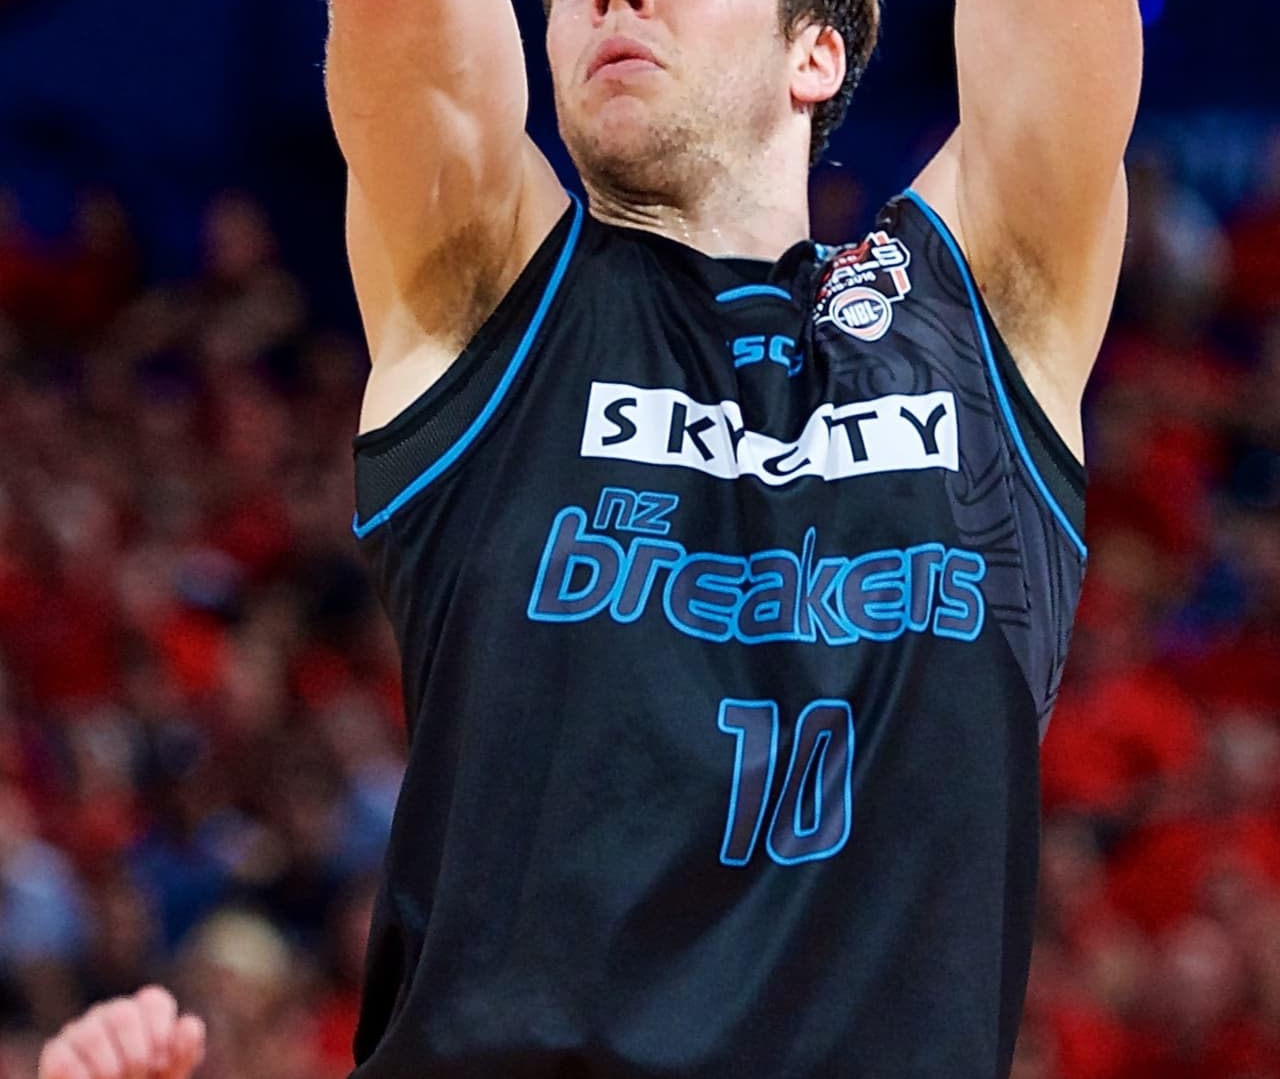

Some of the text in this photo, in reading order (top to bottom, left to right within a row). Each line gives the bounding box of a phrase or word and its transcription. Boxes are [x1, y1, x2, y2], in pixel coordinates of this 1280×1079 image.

[842, 300, 880, 327] NBL
[601, 397, 947, 476] SKCTY
[526, 506, 986, 647] breakers
[718, 698, 855, 867] 10
